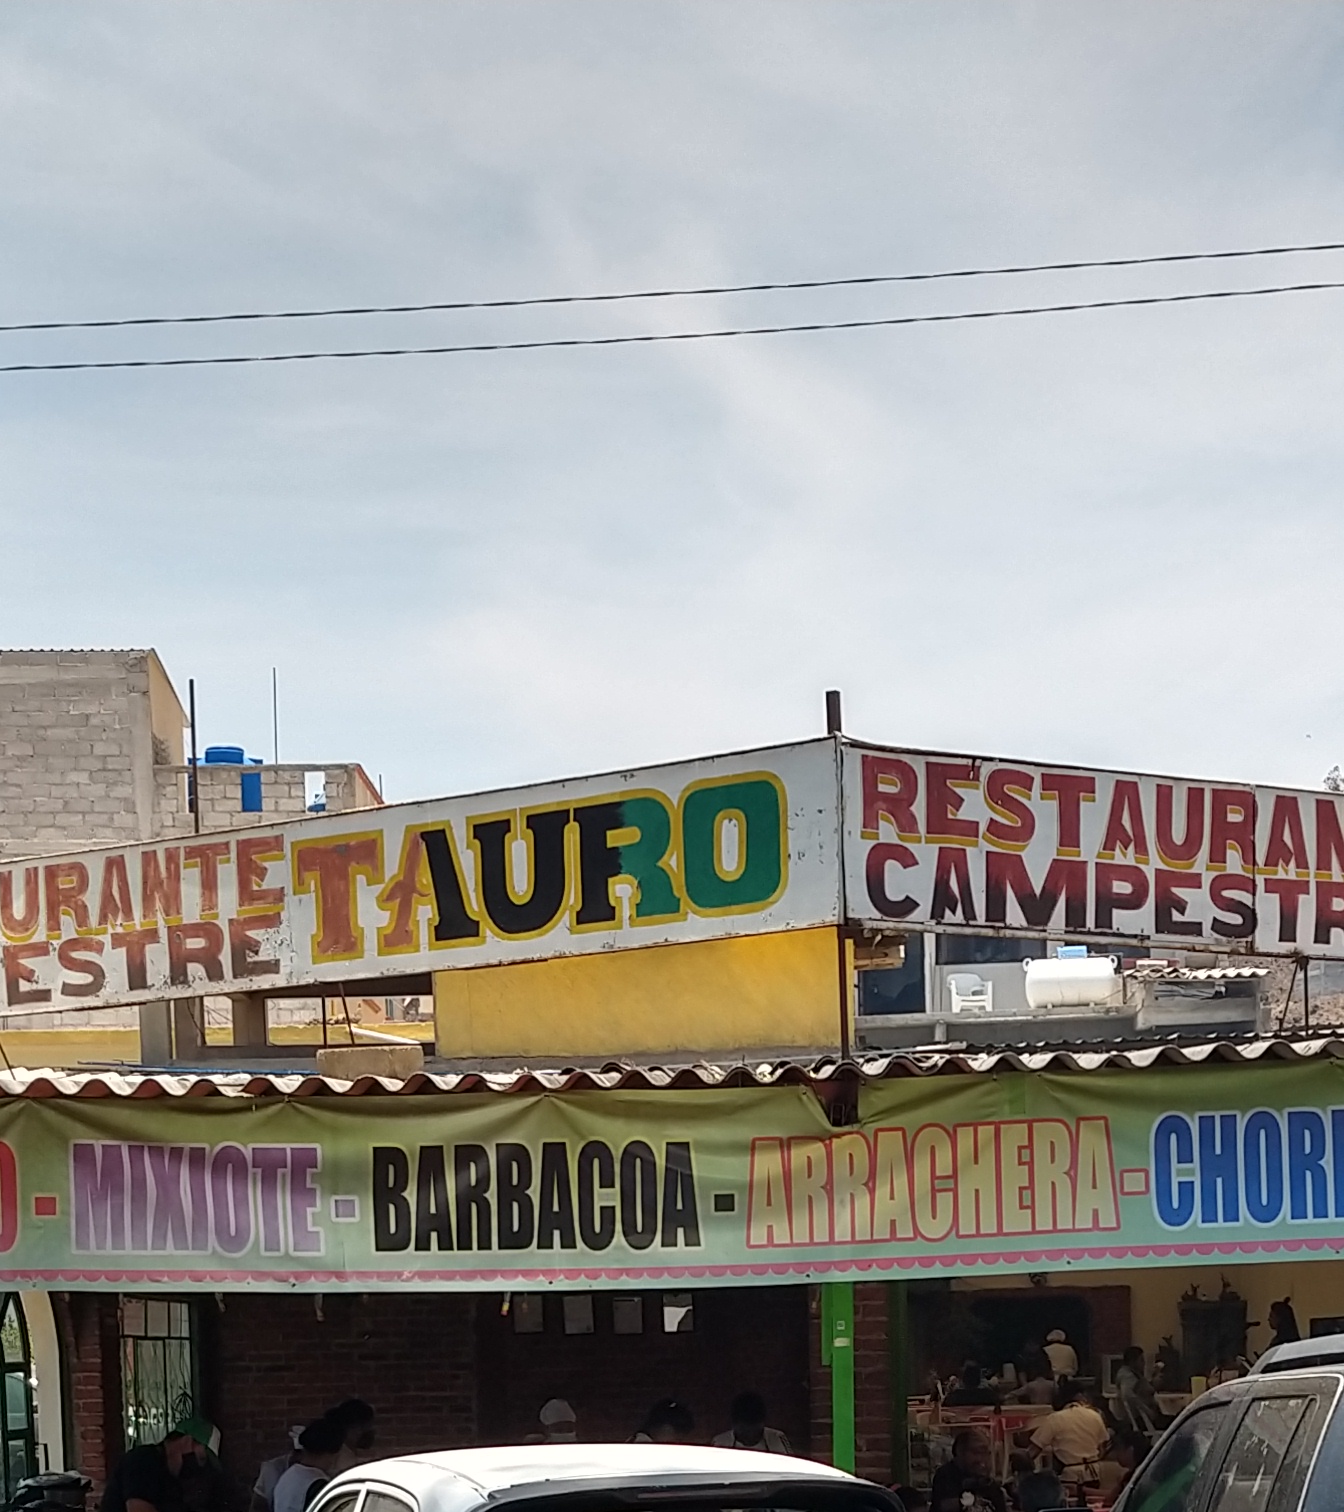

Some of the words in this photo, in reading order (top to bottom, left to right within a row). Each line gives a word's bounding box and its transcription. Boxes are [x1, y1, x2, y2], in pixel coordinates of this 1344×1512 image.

[292, 770, 789, 964] TAURO
[70, 1142, 326, 1256] MIXIOTE
[372, 1139, 702, 1253] BARBACOA
[746, 1114, 1120, 1249] ARRACHERA
